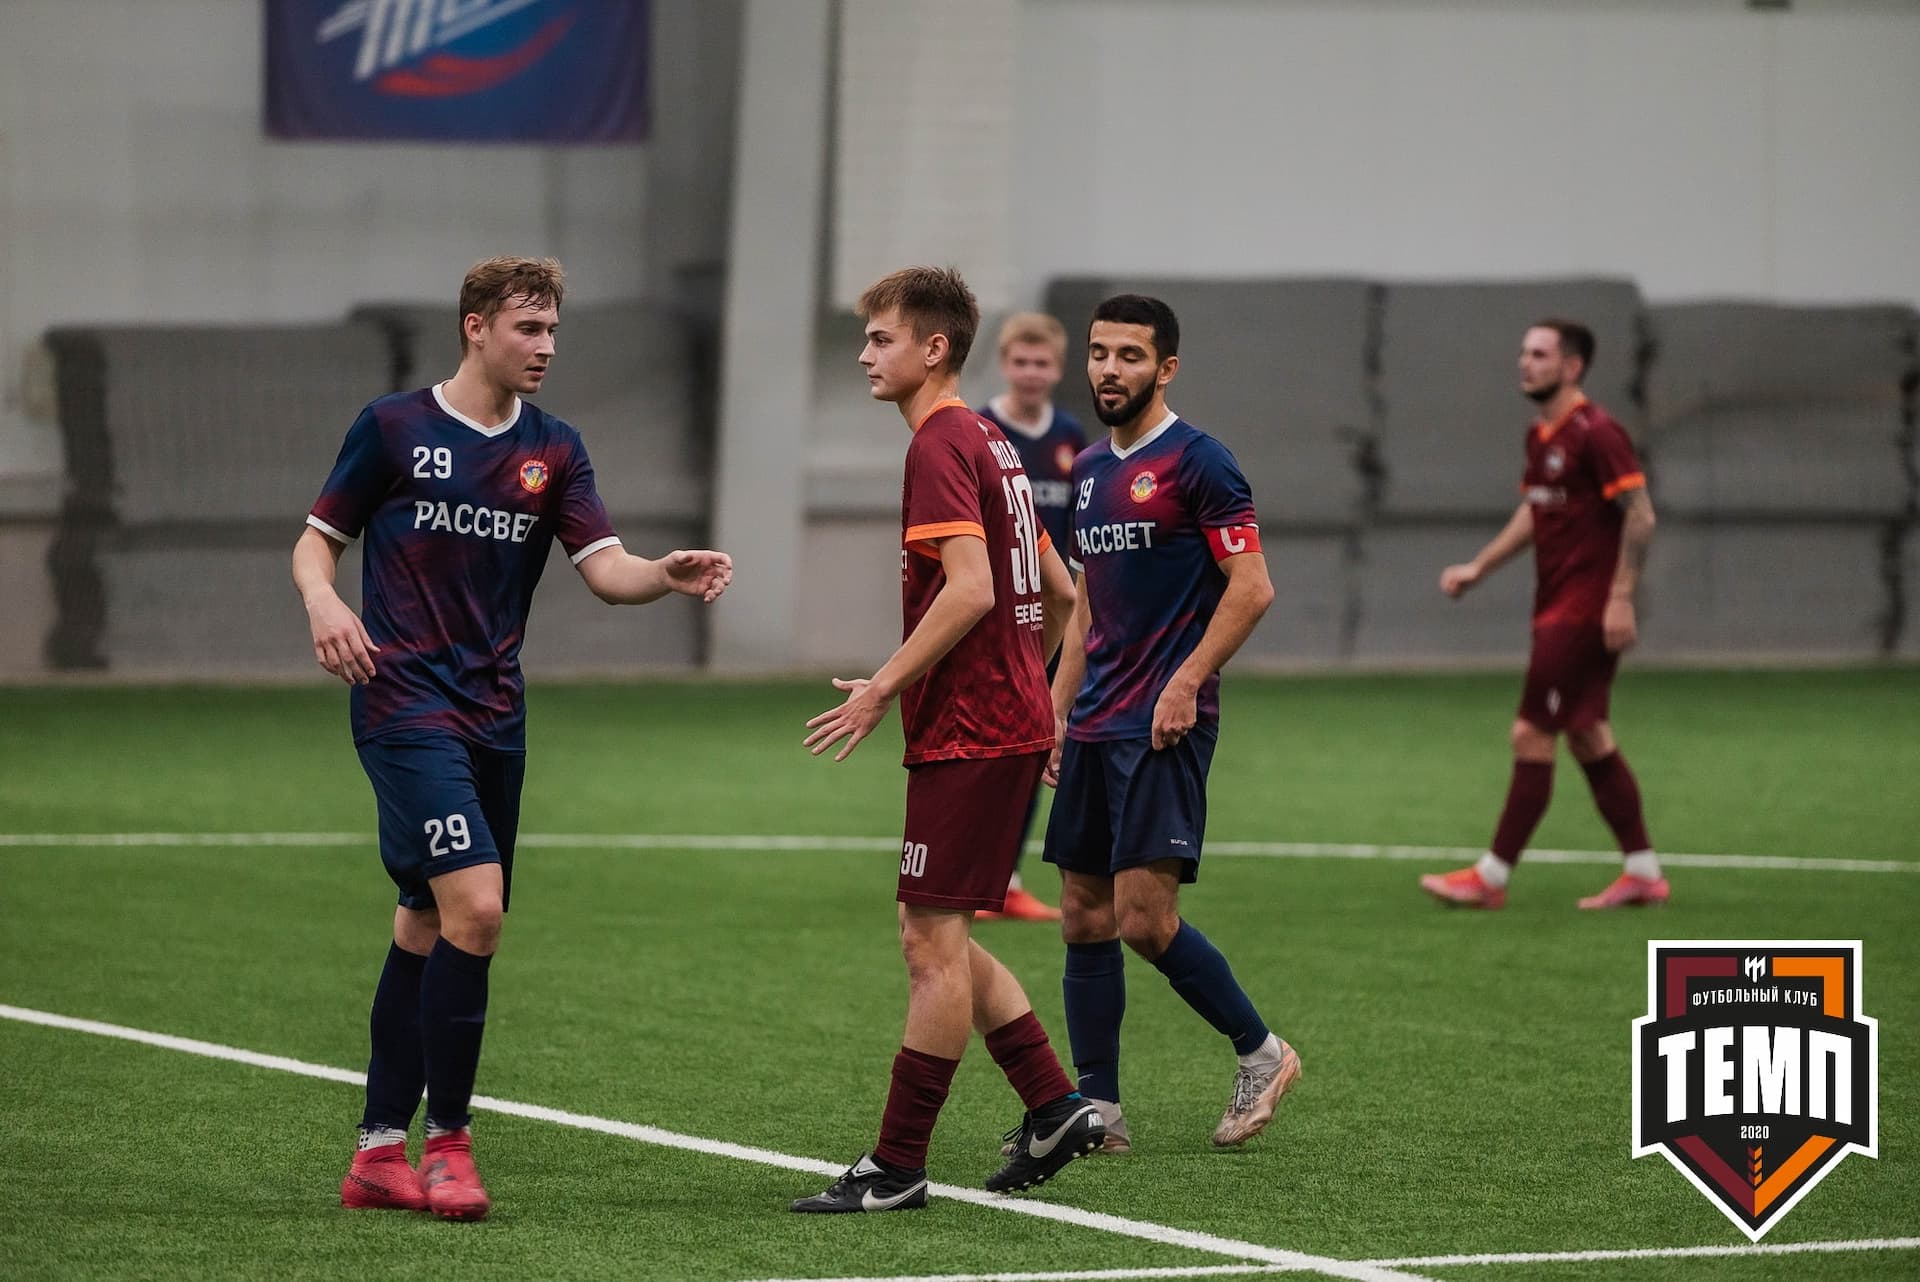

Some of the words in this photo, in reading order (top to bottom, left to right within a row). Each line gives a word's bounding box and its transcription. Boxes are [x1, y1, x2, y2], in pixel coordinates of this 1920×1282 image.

[412, 446, 452, 479] 29
[1076, 477, 1095, 512] 19
[414, 501, 539, 543] РАССВЕТ
[1002, 474, 1041, 595] 30
[424, 813, 471, 857] 29
[901, 841, 928, 878] 30
